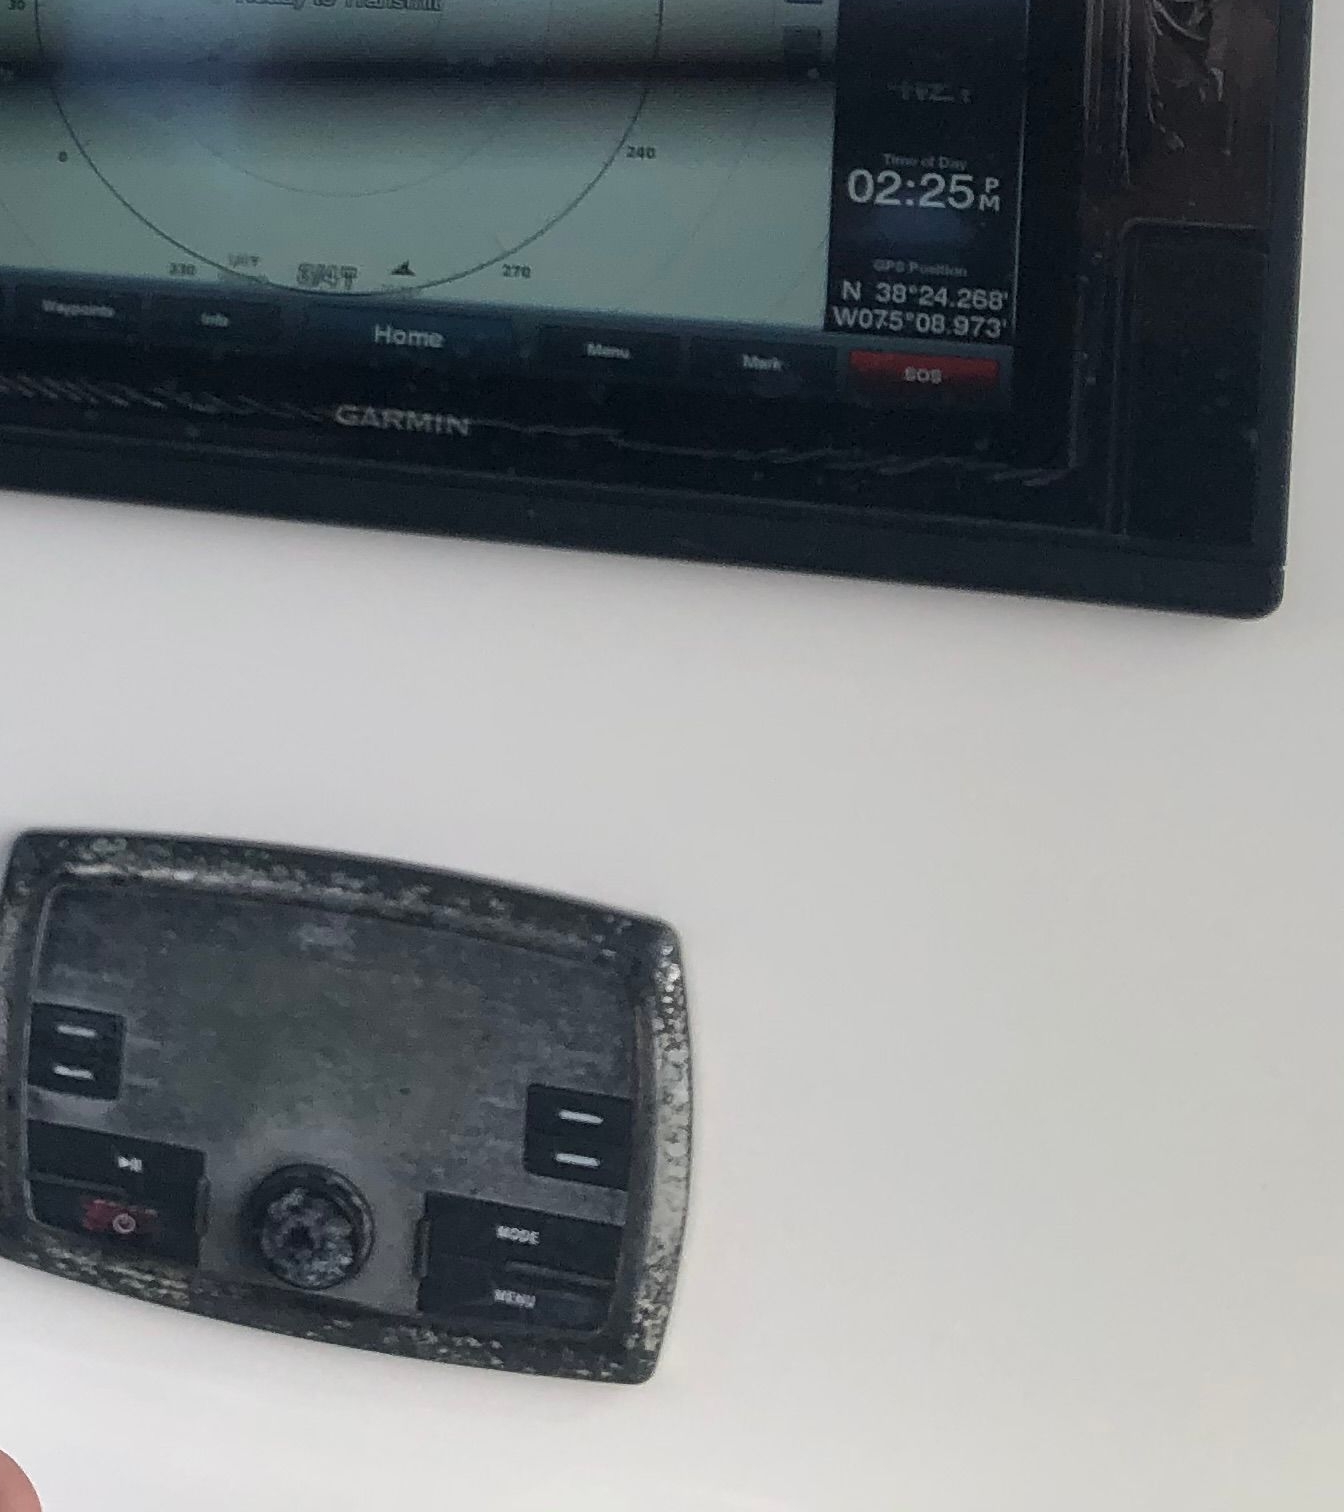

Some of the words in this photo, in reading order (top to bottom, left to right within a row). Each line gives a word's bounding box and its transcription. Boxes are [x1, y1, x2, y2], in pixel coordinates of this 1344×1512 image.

[626, 146, 656, 160] 240
[883, 153, 916, 167] Time
[920, 154, 935, 168] of
[939, 157, 967, 171] Day
[847, 168, 975, 210] 02:25
[501, 263, 531, 278] 270
[872, 258, 905, 274] GPS
[908, 261, 967, 278] Position
[843, 279, 862, 301] N
[374, 324, 445, 349] Home
[904, 367, 944, 384] SOS
[335, 404, 470, 437] GARMIN
[496, 1225, 540, 1245] MODE
[494, 1289, 537, 1309] MENU
